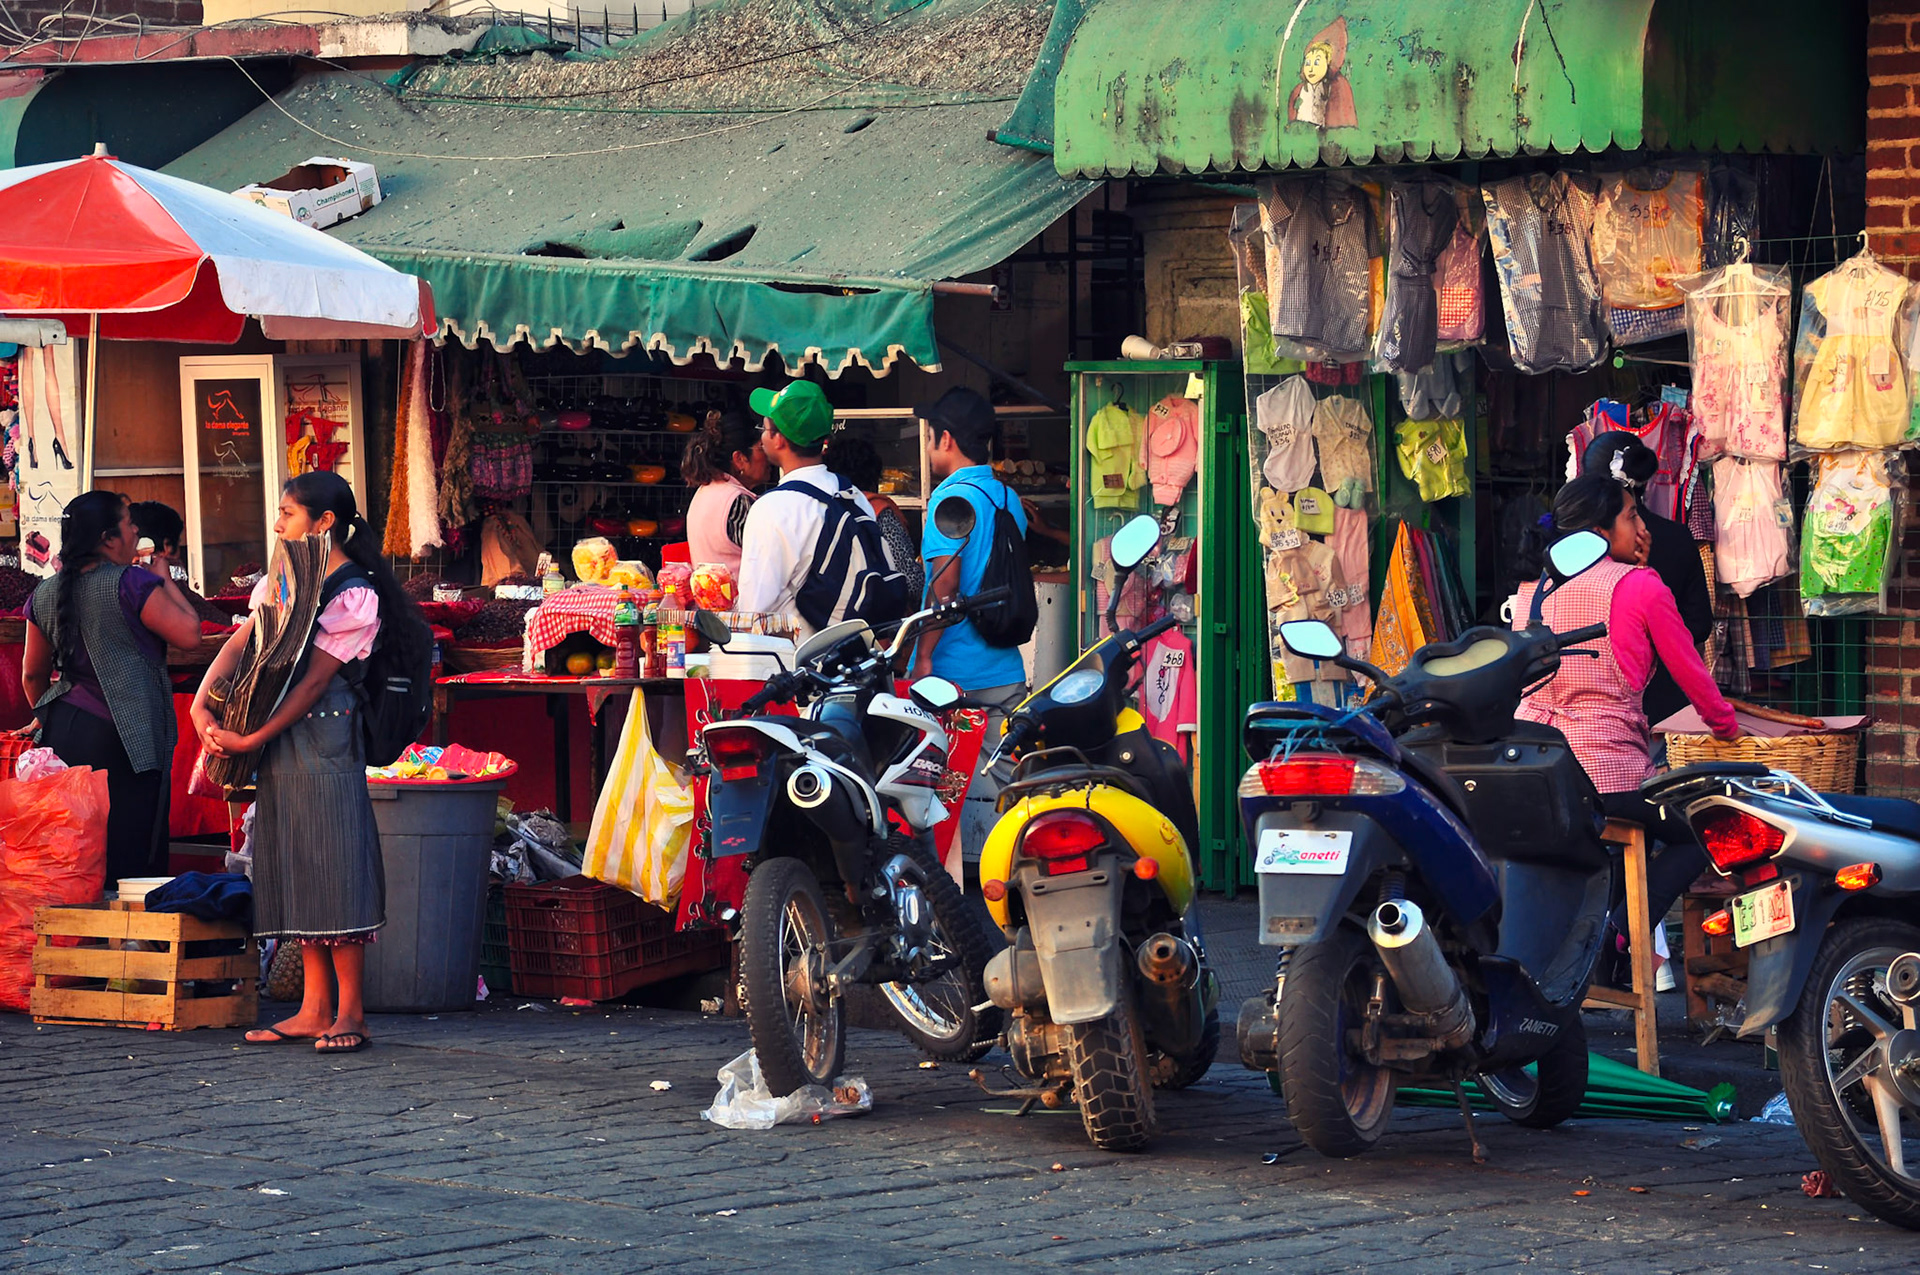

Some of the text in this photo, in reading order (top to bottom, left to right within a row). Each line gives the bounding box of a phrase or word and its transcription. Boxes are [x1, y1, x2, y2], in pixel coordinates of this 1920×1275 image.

[48, 515, 62, 524] eleg
[1164, 652, 1184, 666] $68
[1519, 1017, 1559, 1037] ZANETTI
